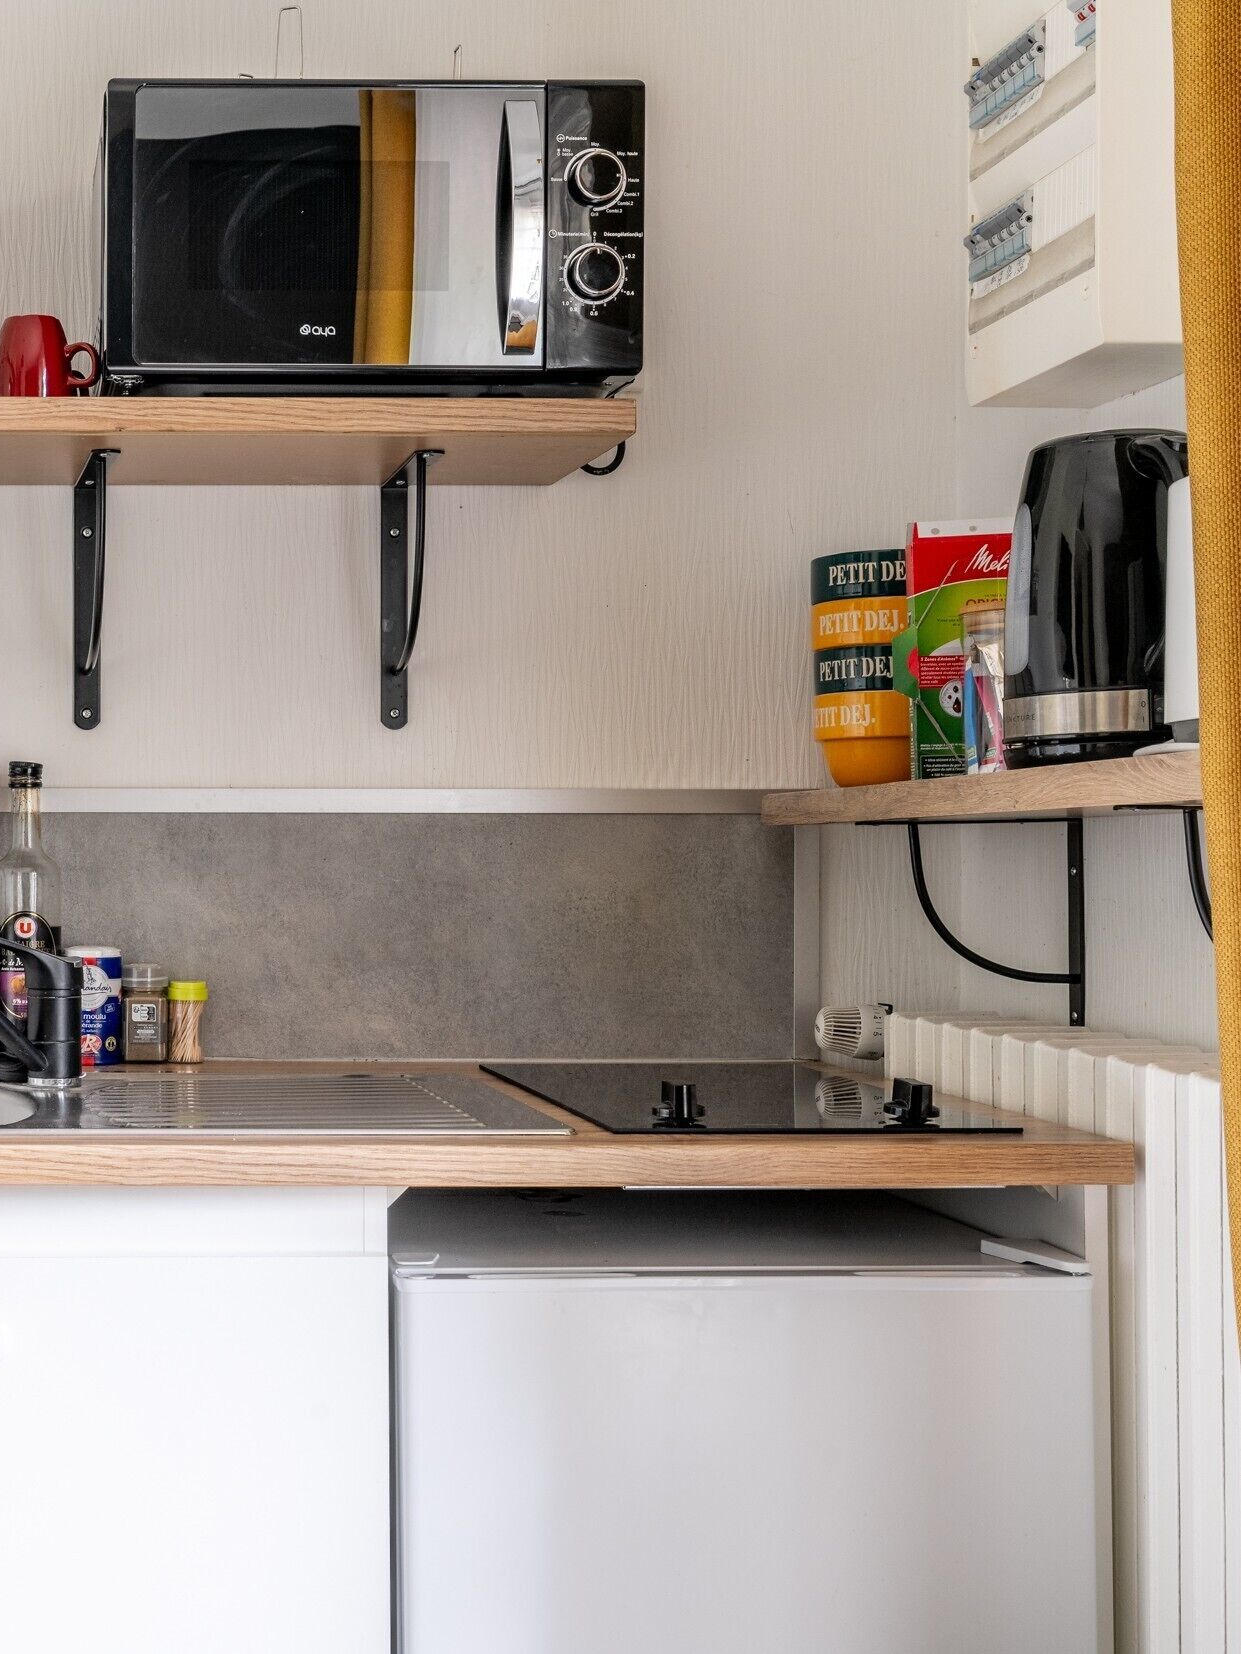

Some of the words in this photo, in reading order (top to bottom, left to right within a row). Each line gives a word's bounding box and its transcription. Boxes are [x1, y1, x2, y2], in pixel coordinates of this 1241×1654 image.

[963, 543, 1011, 573] Meli
[829, 561, 877, 587] PETIT
[880, 560, 906, 582] DE
[819, 611, 861, 636] PETIT
[864, 609, 904, 633] DEJ.
[819, 657, 854, 682] PETIT
[814, 706, 838, 729] ETIT
[840, 703, 876, 727] DEJ.
[19, 922, 32, 934] U
[83, 982, 112, 992] andais
